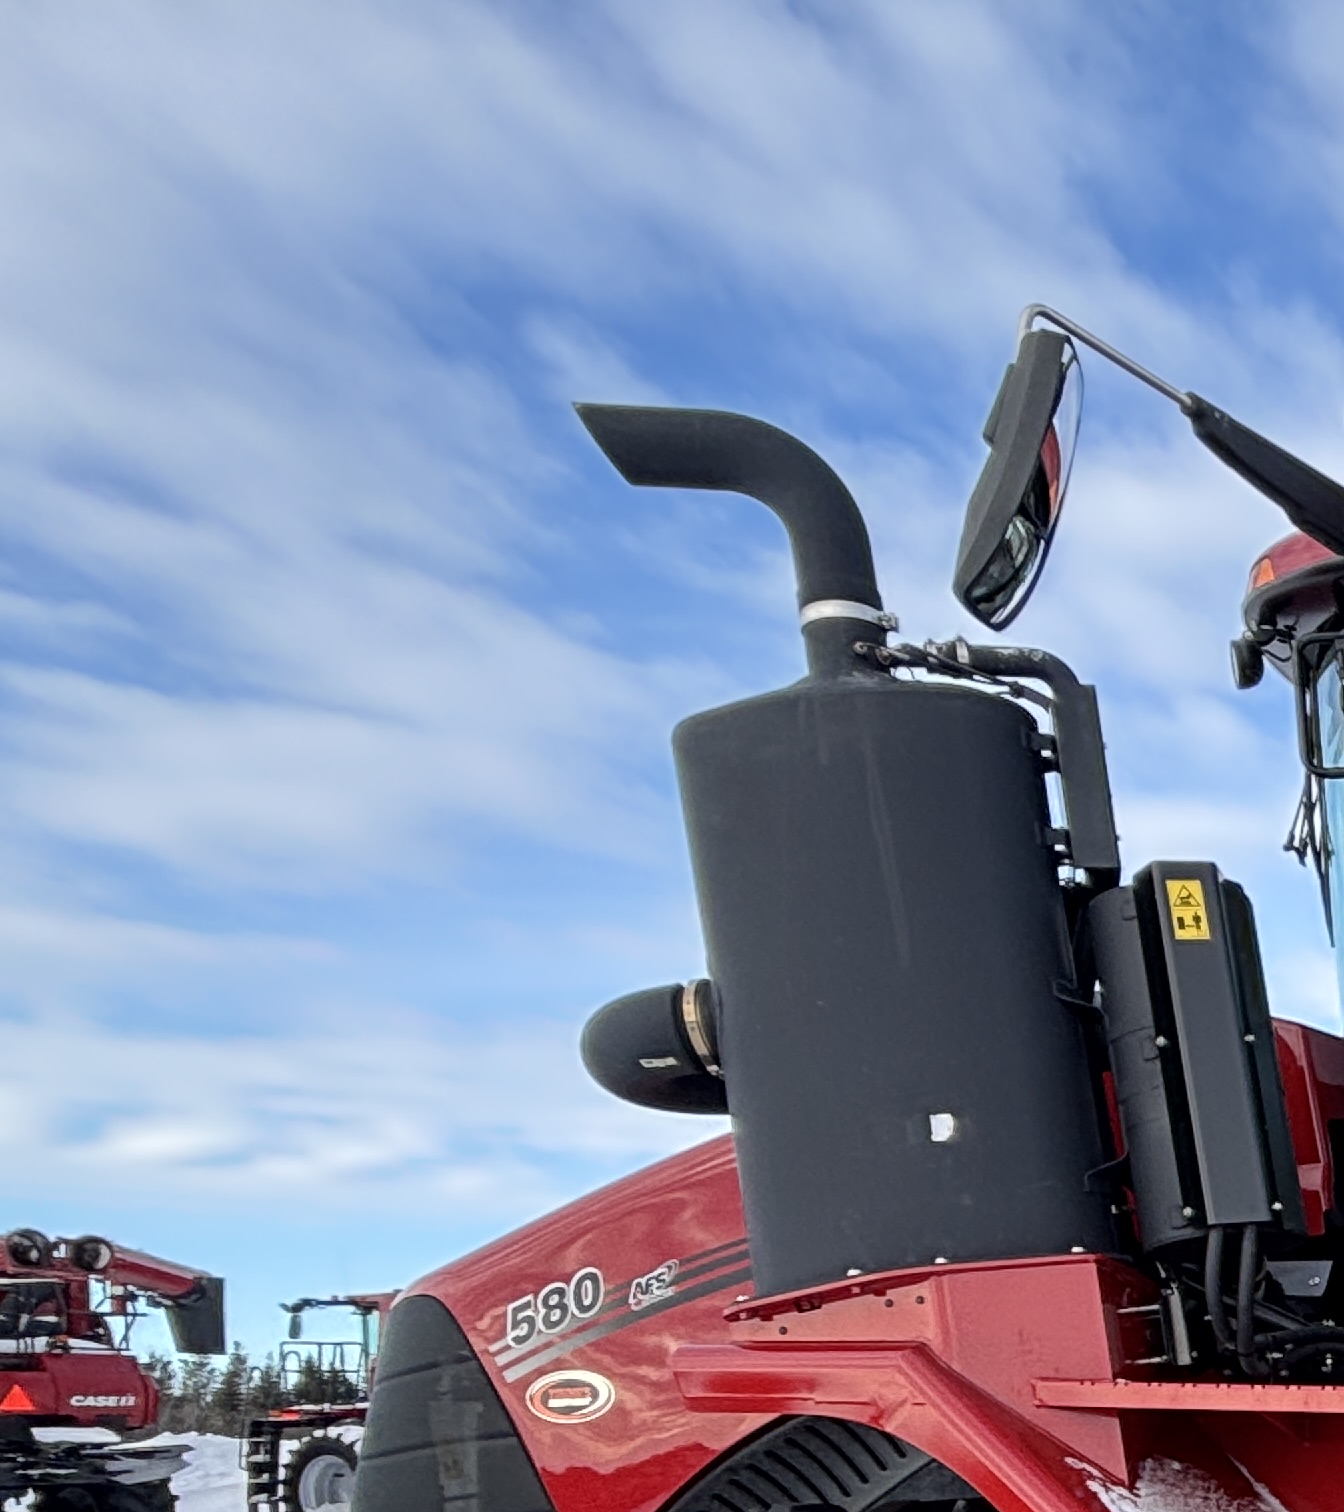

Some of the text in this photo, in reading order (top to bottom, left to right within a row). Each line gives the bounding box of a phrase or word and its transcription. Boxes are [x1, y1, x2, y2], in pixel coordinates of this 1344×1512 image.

[630, 1268, 670, 1302] AFS
[506, 1266, 604, 1349] 580
[69, 1395, 119, 1407] CASE
